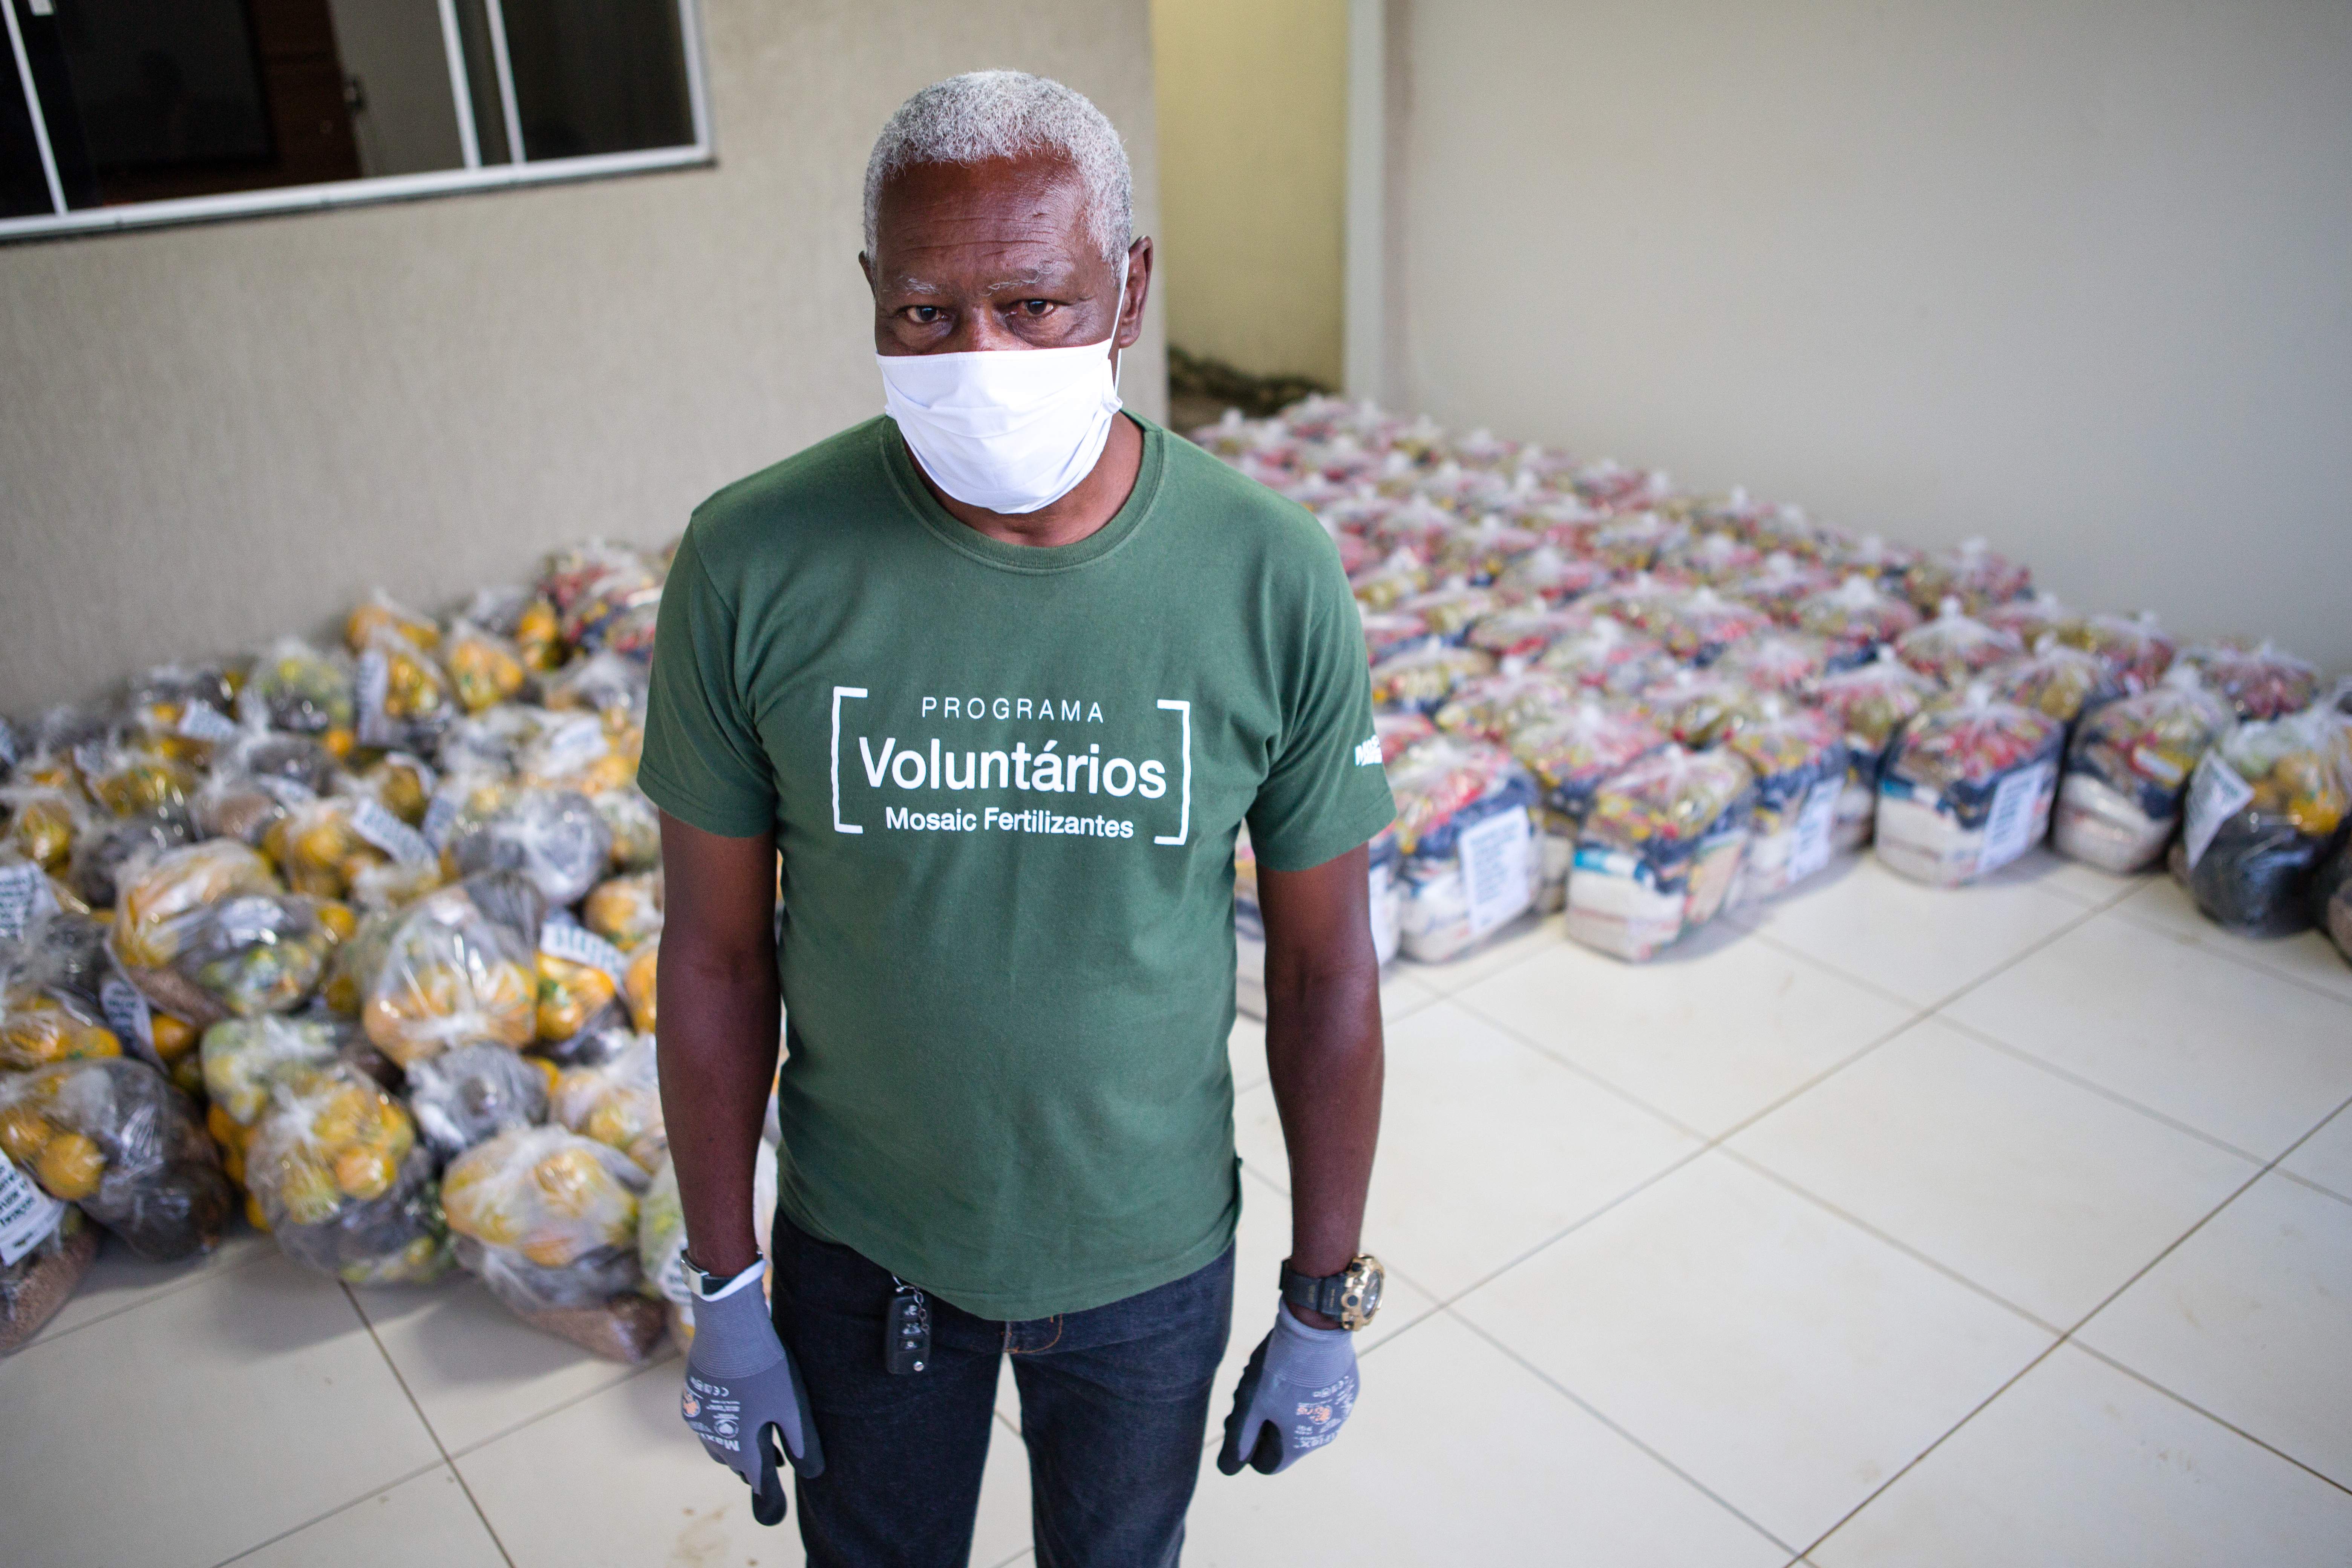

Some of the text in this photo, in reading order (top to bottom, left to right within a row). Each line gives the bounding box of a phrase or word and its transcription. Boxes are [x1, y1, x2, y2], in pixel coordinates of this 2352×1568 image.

[922, 696, 1104, 724] PROGRAMA
[859, 737, 1167, 799] Voluntários
[886, 807, 1134, 839] Mosaic Fertilizantes
